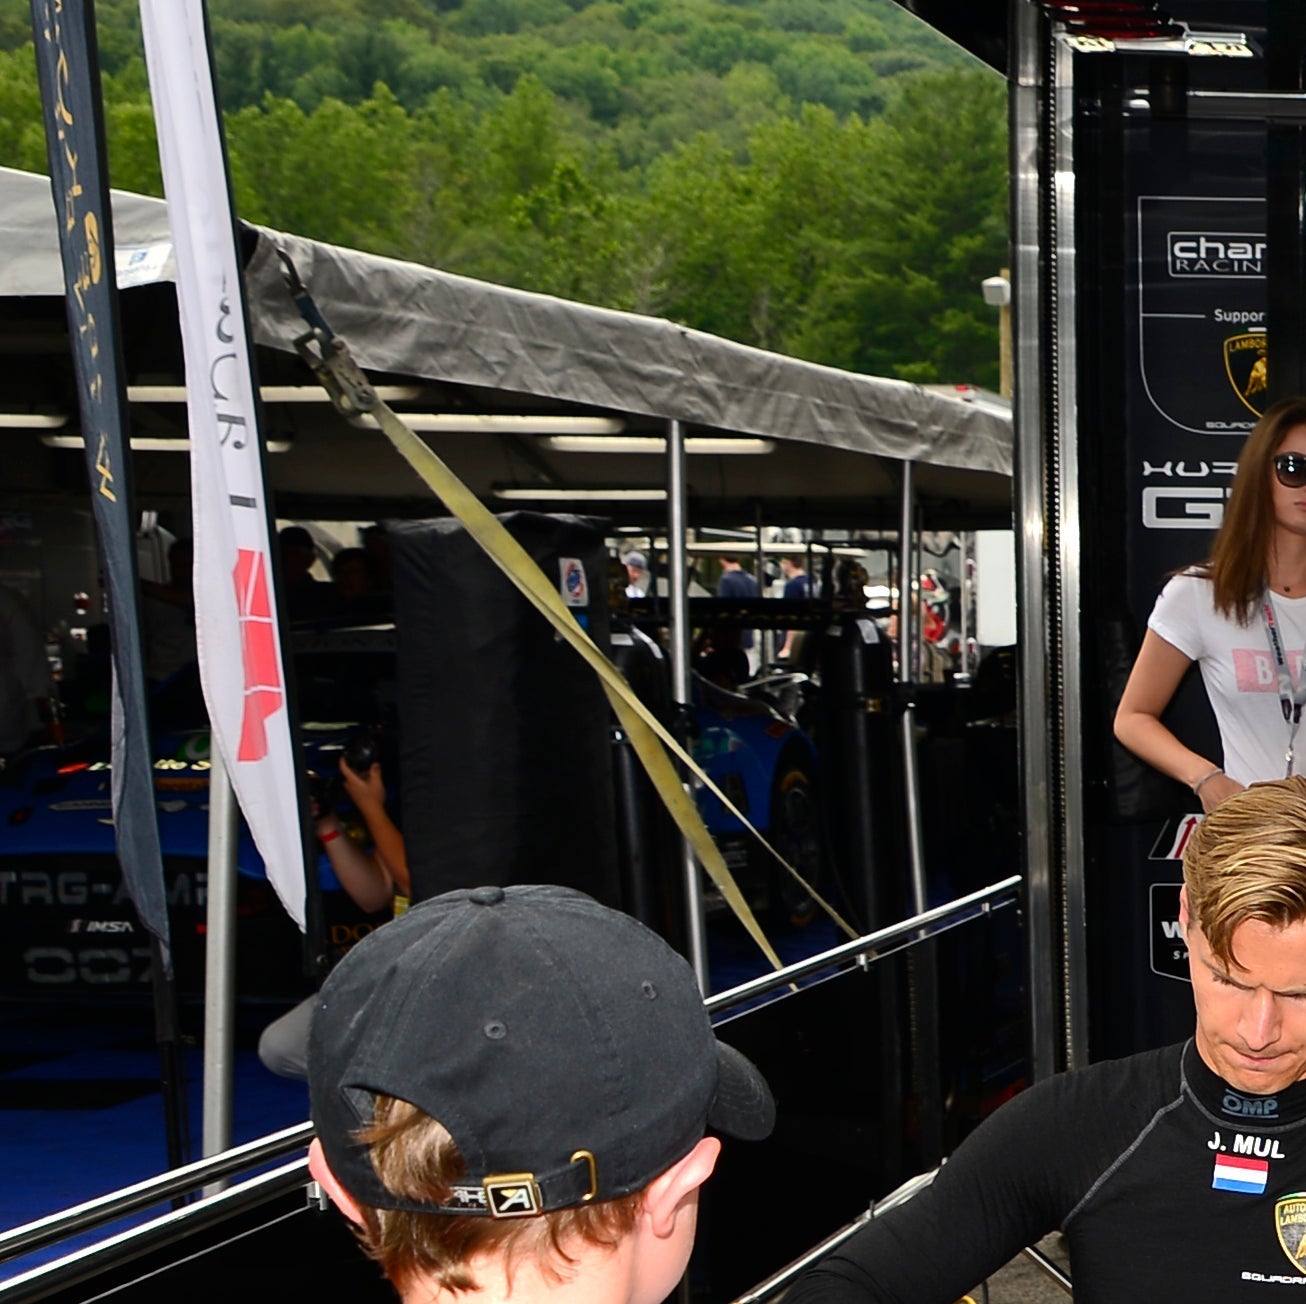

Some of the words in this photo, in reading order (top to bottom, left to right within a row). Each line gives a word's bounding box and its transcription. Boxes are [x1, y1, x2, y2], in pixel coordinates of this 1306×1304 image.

[1174, 236, 1267, 259] char
[1175, 260, 1262, 273] RACIN
[1214, 308, 1266, 324] Suppor
[1229, 337, 1268, 353] LAMBOR
[1221, 1095, 1279, 1118] OMP
[1207, 1130, 1227, 1152] J.
[1232, 1132, 1286, 1160] MUL
